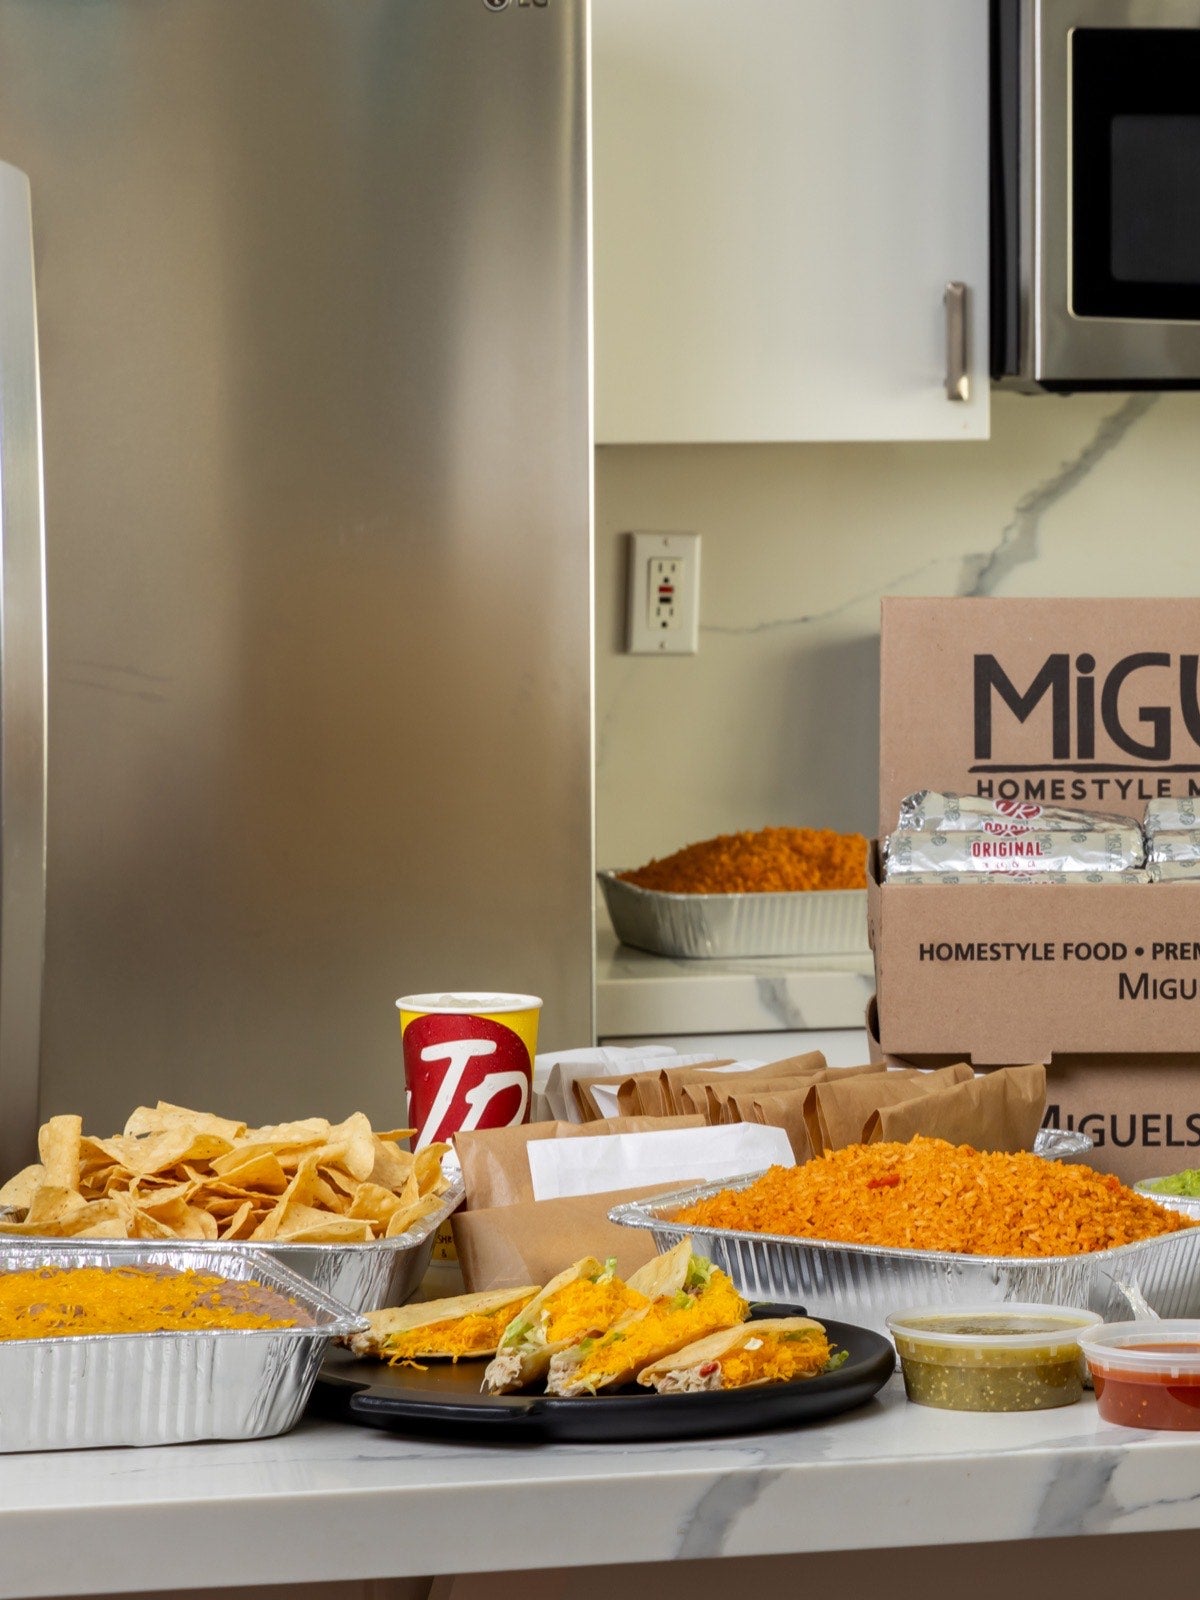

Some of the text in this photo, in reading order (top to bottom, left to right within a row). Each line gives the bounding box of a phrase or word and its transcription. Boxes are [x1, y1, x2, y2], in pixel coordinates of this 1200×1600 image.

[976, 779, 1172, 800] HOMESTYLE
[971, 841, 1044, 858] ORIGINAL
[918, 942, 1055, 962] HOMESTYLE
[1062, 942, 1128, 962] FOOD
